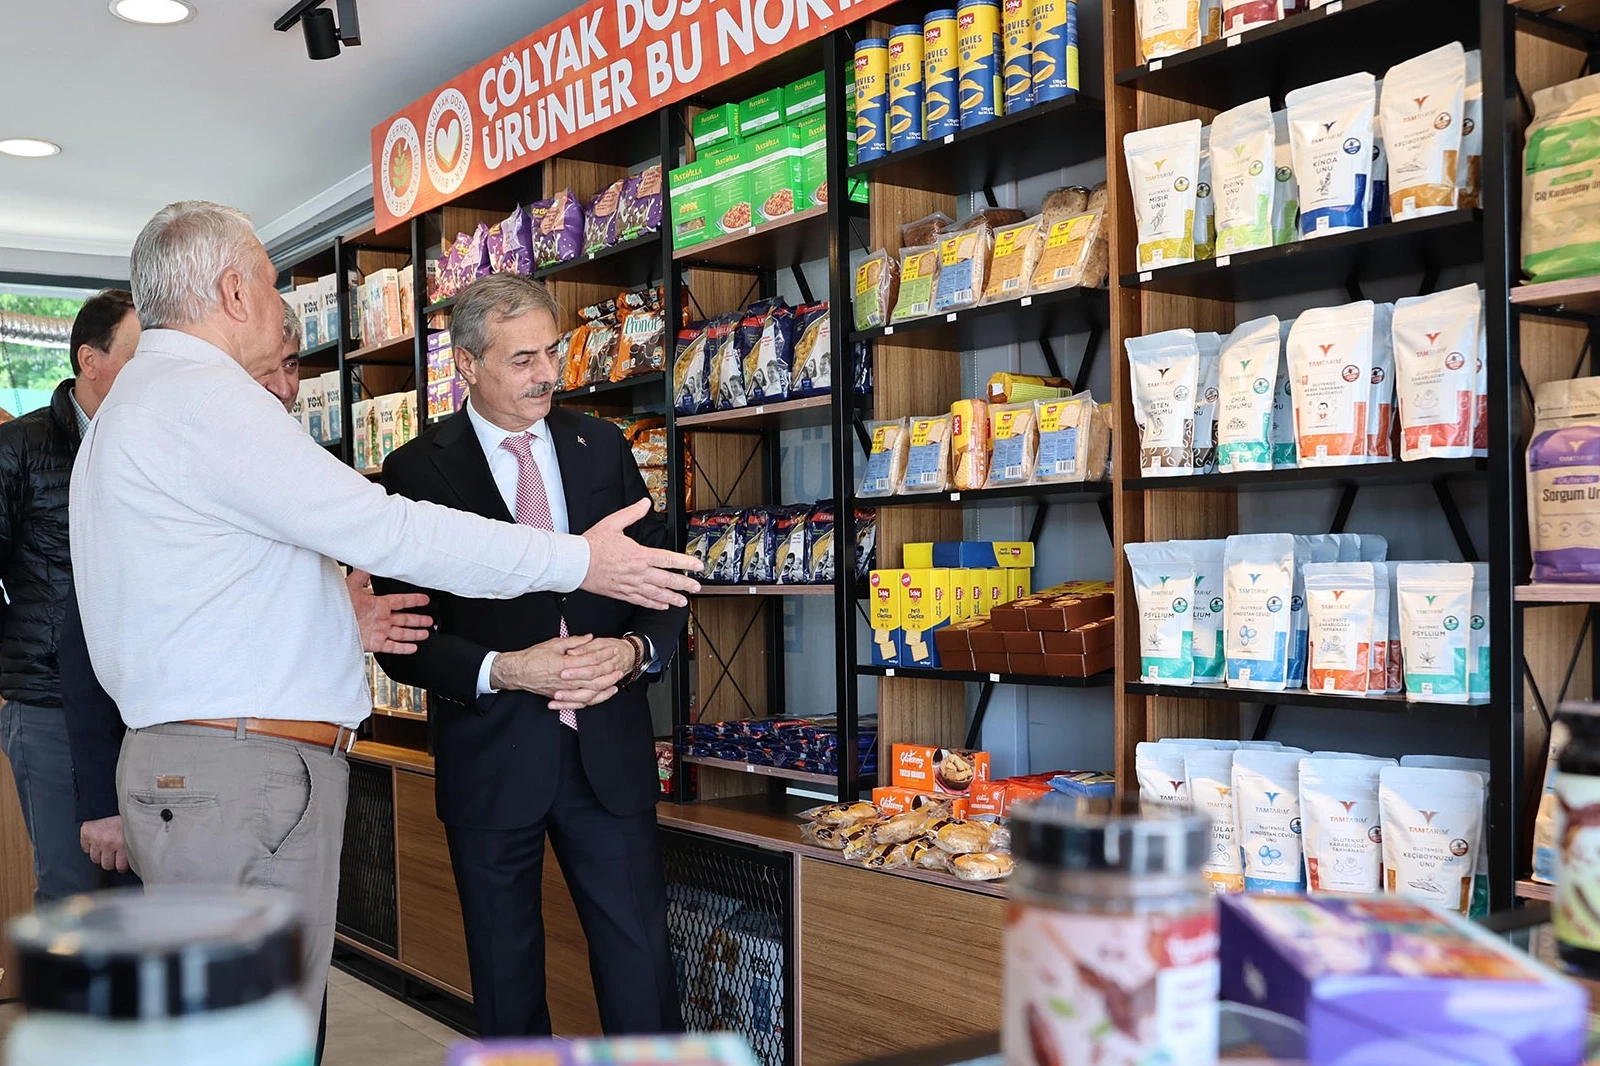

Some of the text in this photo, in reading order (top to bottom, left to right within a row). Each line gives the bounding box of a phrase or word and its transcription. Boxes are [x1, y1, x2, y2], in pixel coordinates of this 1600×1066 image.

[478, 7, 608, 121] ÇÖLYAK
[482, 58, 638, 170] ÜRÜNLER
[646, 21, 703, 99] BU
[450, 94, 468, 122] DOSTU
[1316, 165, 1334, 174] UNU
[1228, 188, 1244, 196] UNU
[1150, 196, 1170, 205] MISIR
[1152, 203, 1168, 212] UNU
[1225, 402, 1252, 411] TOHUMU
[1542, 488, 1584, 503] Sorgum
[1330, 816, 1368, 824] TAMTARIM
[1408, 826, 1450, 835] TAMTARIM
